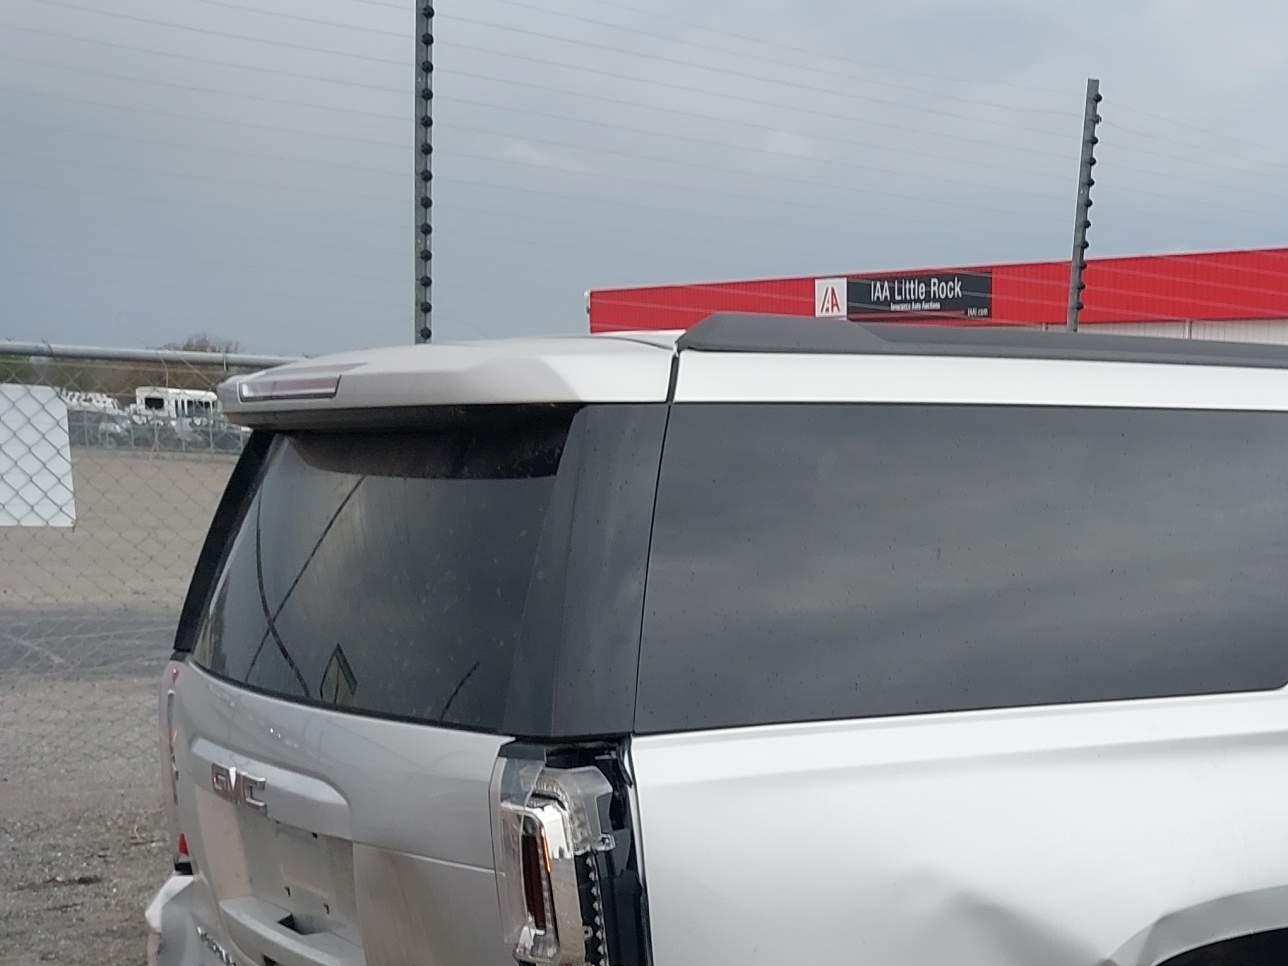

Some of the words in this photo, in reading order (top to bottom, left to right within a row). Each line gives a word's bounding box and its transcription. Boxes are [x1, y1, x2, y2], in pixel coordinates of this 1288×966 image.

[871, 281, 893, 304] IAA
[895, 279, 926, 303] Little
[931, 276, 962, 300] Rock
[212, 763, 267, 815] GMC
